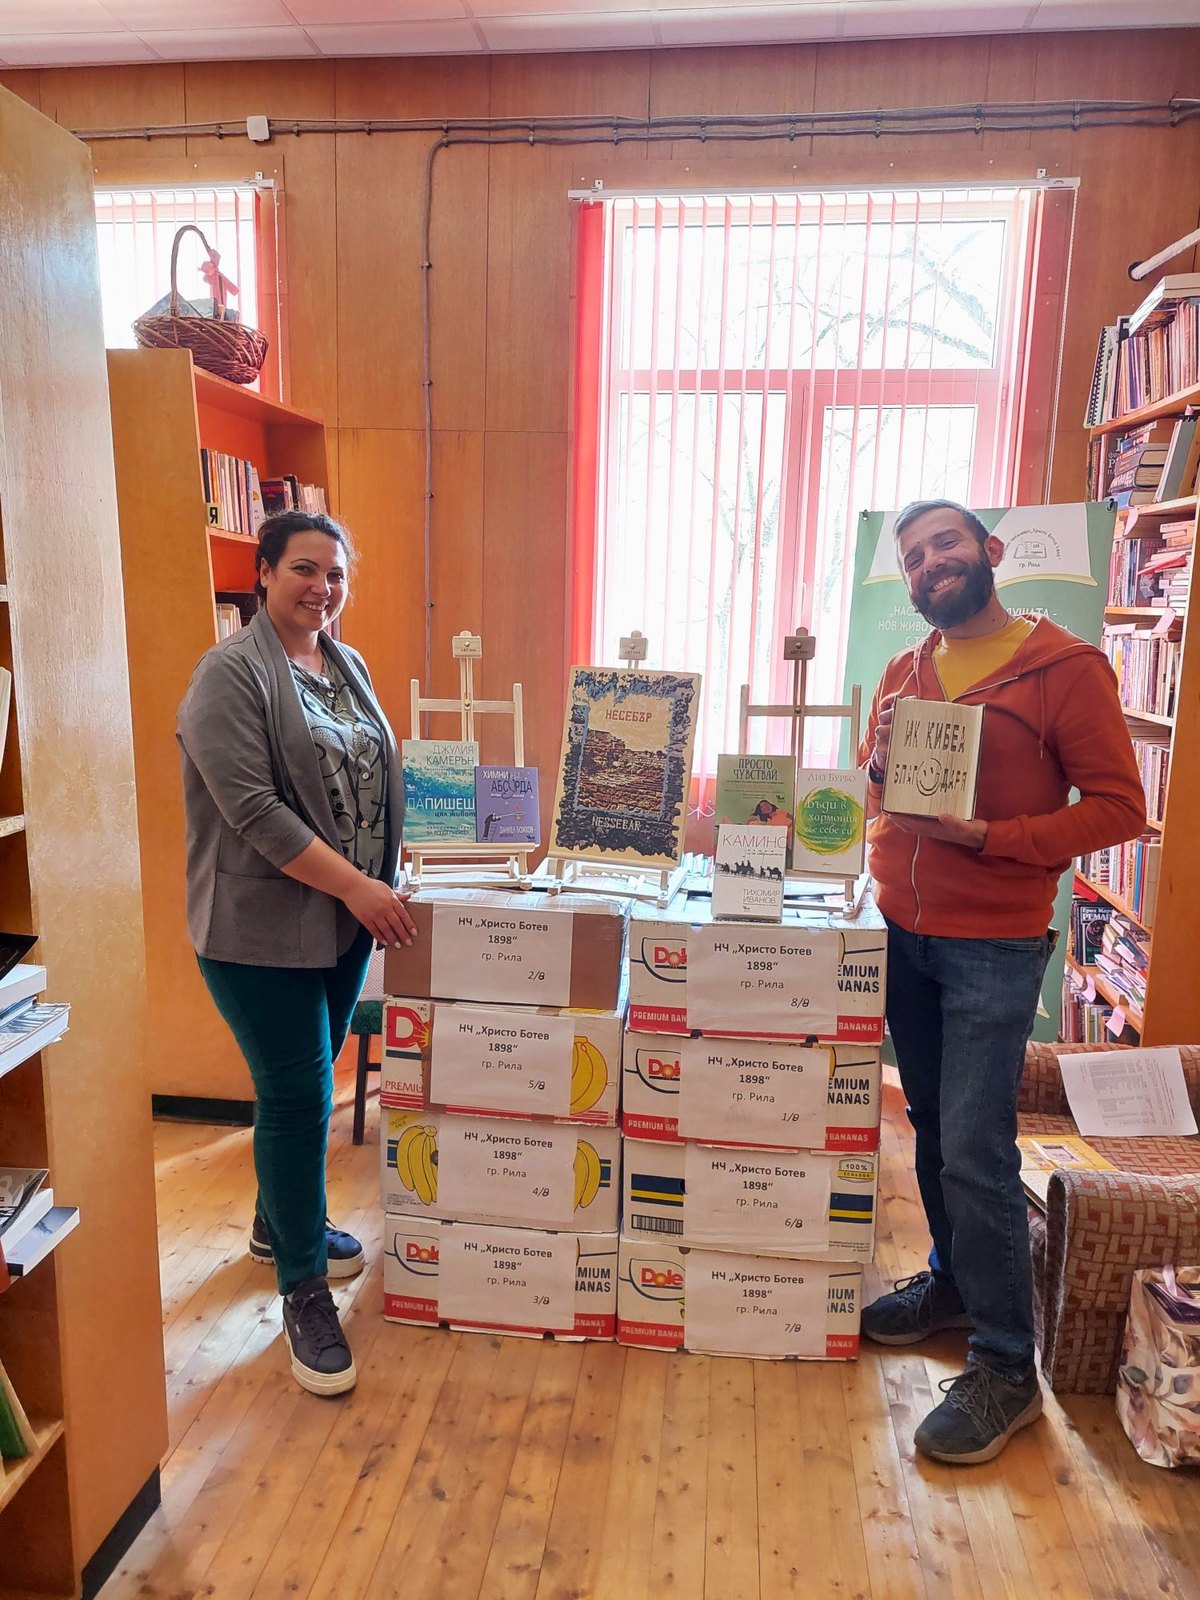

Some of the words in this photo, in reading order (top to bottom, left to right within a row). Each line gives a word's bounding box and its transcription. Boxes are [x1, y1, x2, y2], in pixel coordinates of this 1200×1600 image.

[210, 508, 218, 524] Я
[605, 709, 652, 722] НЕСЕБЪР
[433, 745, 474, 754] ДЖУЛИЯ
[426, 756, 474, 766] КАМЕРЪН
[739, 759, 772, 769] ПРОСТО
[483, 771, 508, 779] ХИМНИ
[734, 768, 777, 780] ЧУВСТВАЙ
[592, 816, 641, 831] NESSEBAR
[459, 917, 472, 926] НЧ
[475, 919, 516, 929] „Христо
[519, 921, 548, 931] Ботев
[714, 943, 729, 952] НЧ
[732, 944, 776, 955] „Христо
[780, 946, 812, 955] Ботев
[482, 953, 494, 961] гр.
[498, 952, 521, 962] Рила
[528, 971, 545, 981] 2/8
[741, 981, 754, 989] гр.
[758, 980, 783, 988] Рила
[791, 998, 809, 1008] 8/8
[633, 1011, 669, 1022] PREMIUM
[459, 1024, 473, 1033] НЧ
[476, 1026, 517, 1037] „Христо
[520, 1029, 549, 1040] Ботев
[482, 1061, 494, 1069] гр.
[498, 1061, 522, 1070] Рила
[708, 1056, 722, 1065] НЧ
[726, 1058, 768, 1068] „Христо
[772, 1061, 803, 1072] Ботев
[528, 1080, 545, 1090] 5/8
[733, 1093, 745, 1102] гр.
[750, 1092, 774, 1103] Рила
[782, 1113, 799, 1122] 1/8
[628, 1120, 664, 1130] PREMIUM
[465, 1132, 478, 1141] НЧ
[481, 1134, 521, 1145] „Христо
[524, 1137, 552, 1148] Ботев
[830, 1133, 868, 1142] BANANAS
[487, 1168, 499, 1176] гр.
[503, 1168, 526, 1178] Рила
[712, 1162, 726, 1170] НЧ
[729, 1163, 771, 1175] „Христо
[775, 1167, 805, 1178] Ботев
[532, 1187, 549, 1197] 4/8
[736, 1199, 749, 1207] гр.
[753, 1199, 778, 1208] Рила
[785, 1218, 803, 1228] 6/8
[464, 1242, 477, 1251] НЧ
[480, 1244, 520, 1255] „Христо
[524, 1248, 552, 1258] Ботев
[503, 1278, 526, 1287] Рила
[641, 1268, 684, 1287] Dole
[712, 1271, 726, 1280] НЧ
[729, 1272, 770, 1283] „Христо
[774, 1275, 804, 1284] Ботев
[533, 1296, 549, 1305] 3/8
[753, 1306, 777, 1315] Рила
[620, 1326, 656, 1336] PREMIUM
[785, 1323, 801, 1333] 7/8
